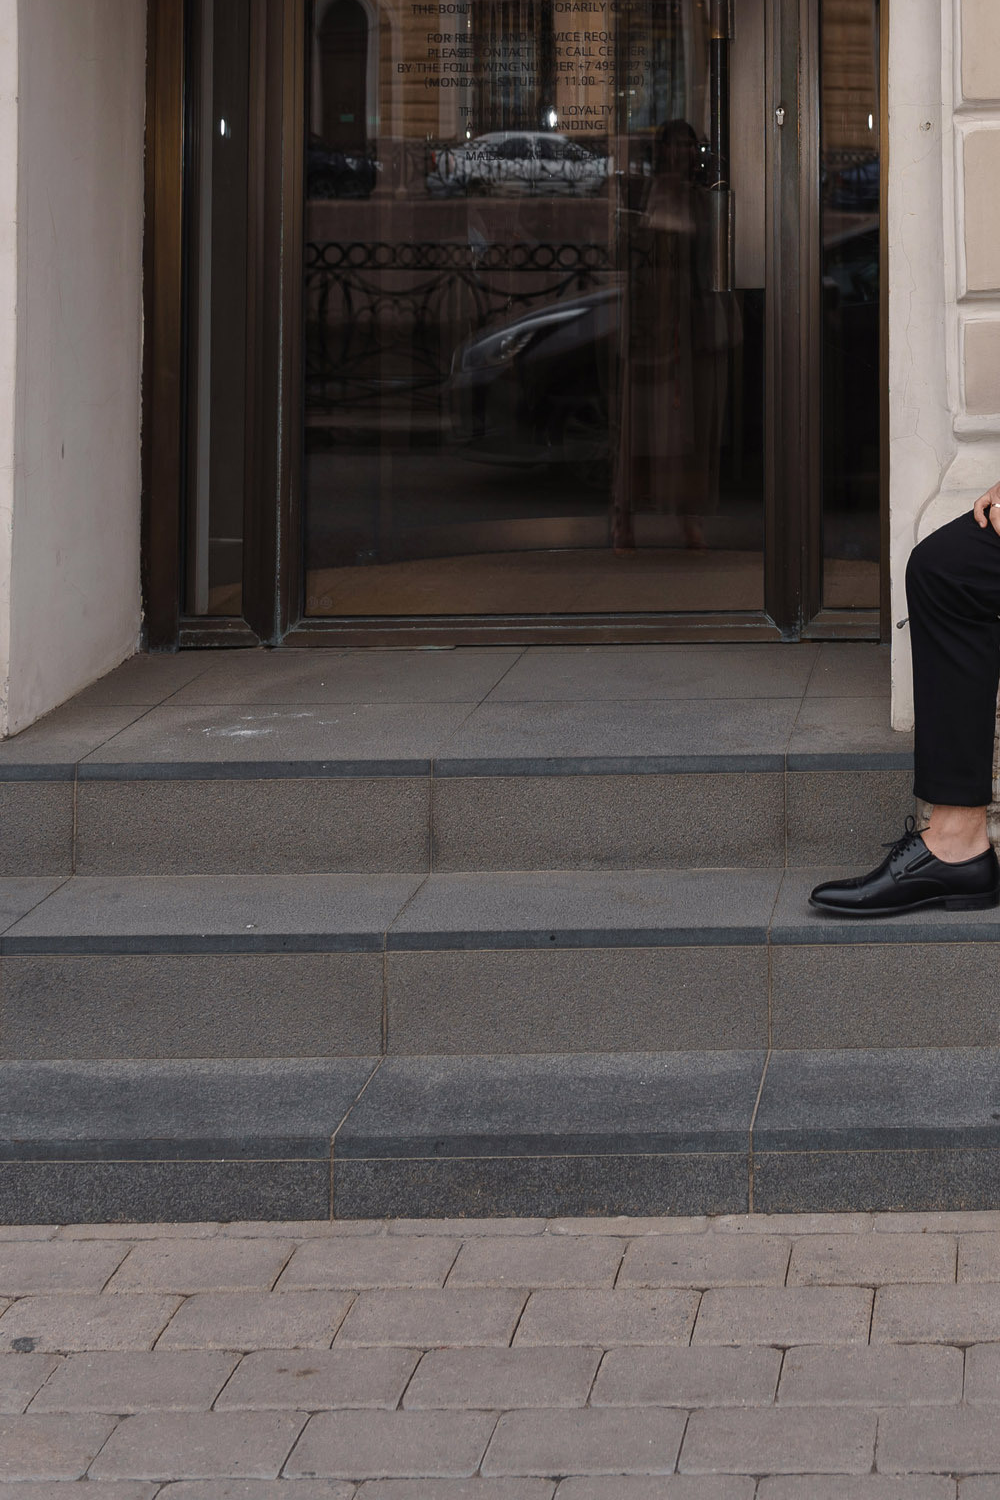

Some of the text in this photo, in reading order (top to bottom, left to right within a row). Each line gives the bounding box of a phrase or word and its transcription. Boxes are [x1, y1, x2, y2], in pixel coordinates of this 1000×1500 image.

[411, 4, 434, 14] THE
[427, 33, 451, 43] FOR
[584, 32, 647, 42] REQU
[428, 48, 472, 58] PLEASE
[474, 47, 531, 57] ONTACT
[566, 46, 594, 56] CALL
[599, 46, 645, 56] CEER
[397, 63, 412, 73] BY
[416, 63, 440, 73] THE
[443, 62, 519, 73] FOLLWING
[521, 61, 573, 72] NUER
[578, 61, 590, 71] +7
[594, 61, 616, 71] 495
[425, 77, 483, 88] (MONDAY
[498, 77, 559, 87] STURY
[565, 76, 595, 86] 11.00
[562, 105, 614, 116] LOYALTY
[466, 151, 513, 161] MAISO
